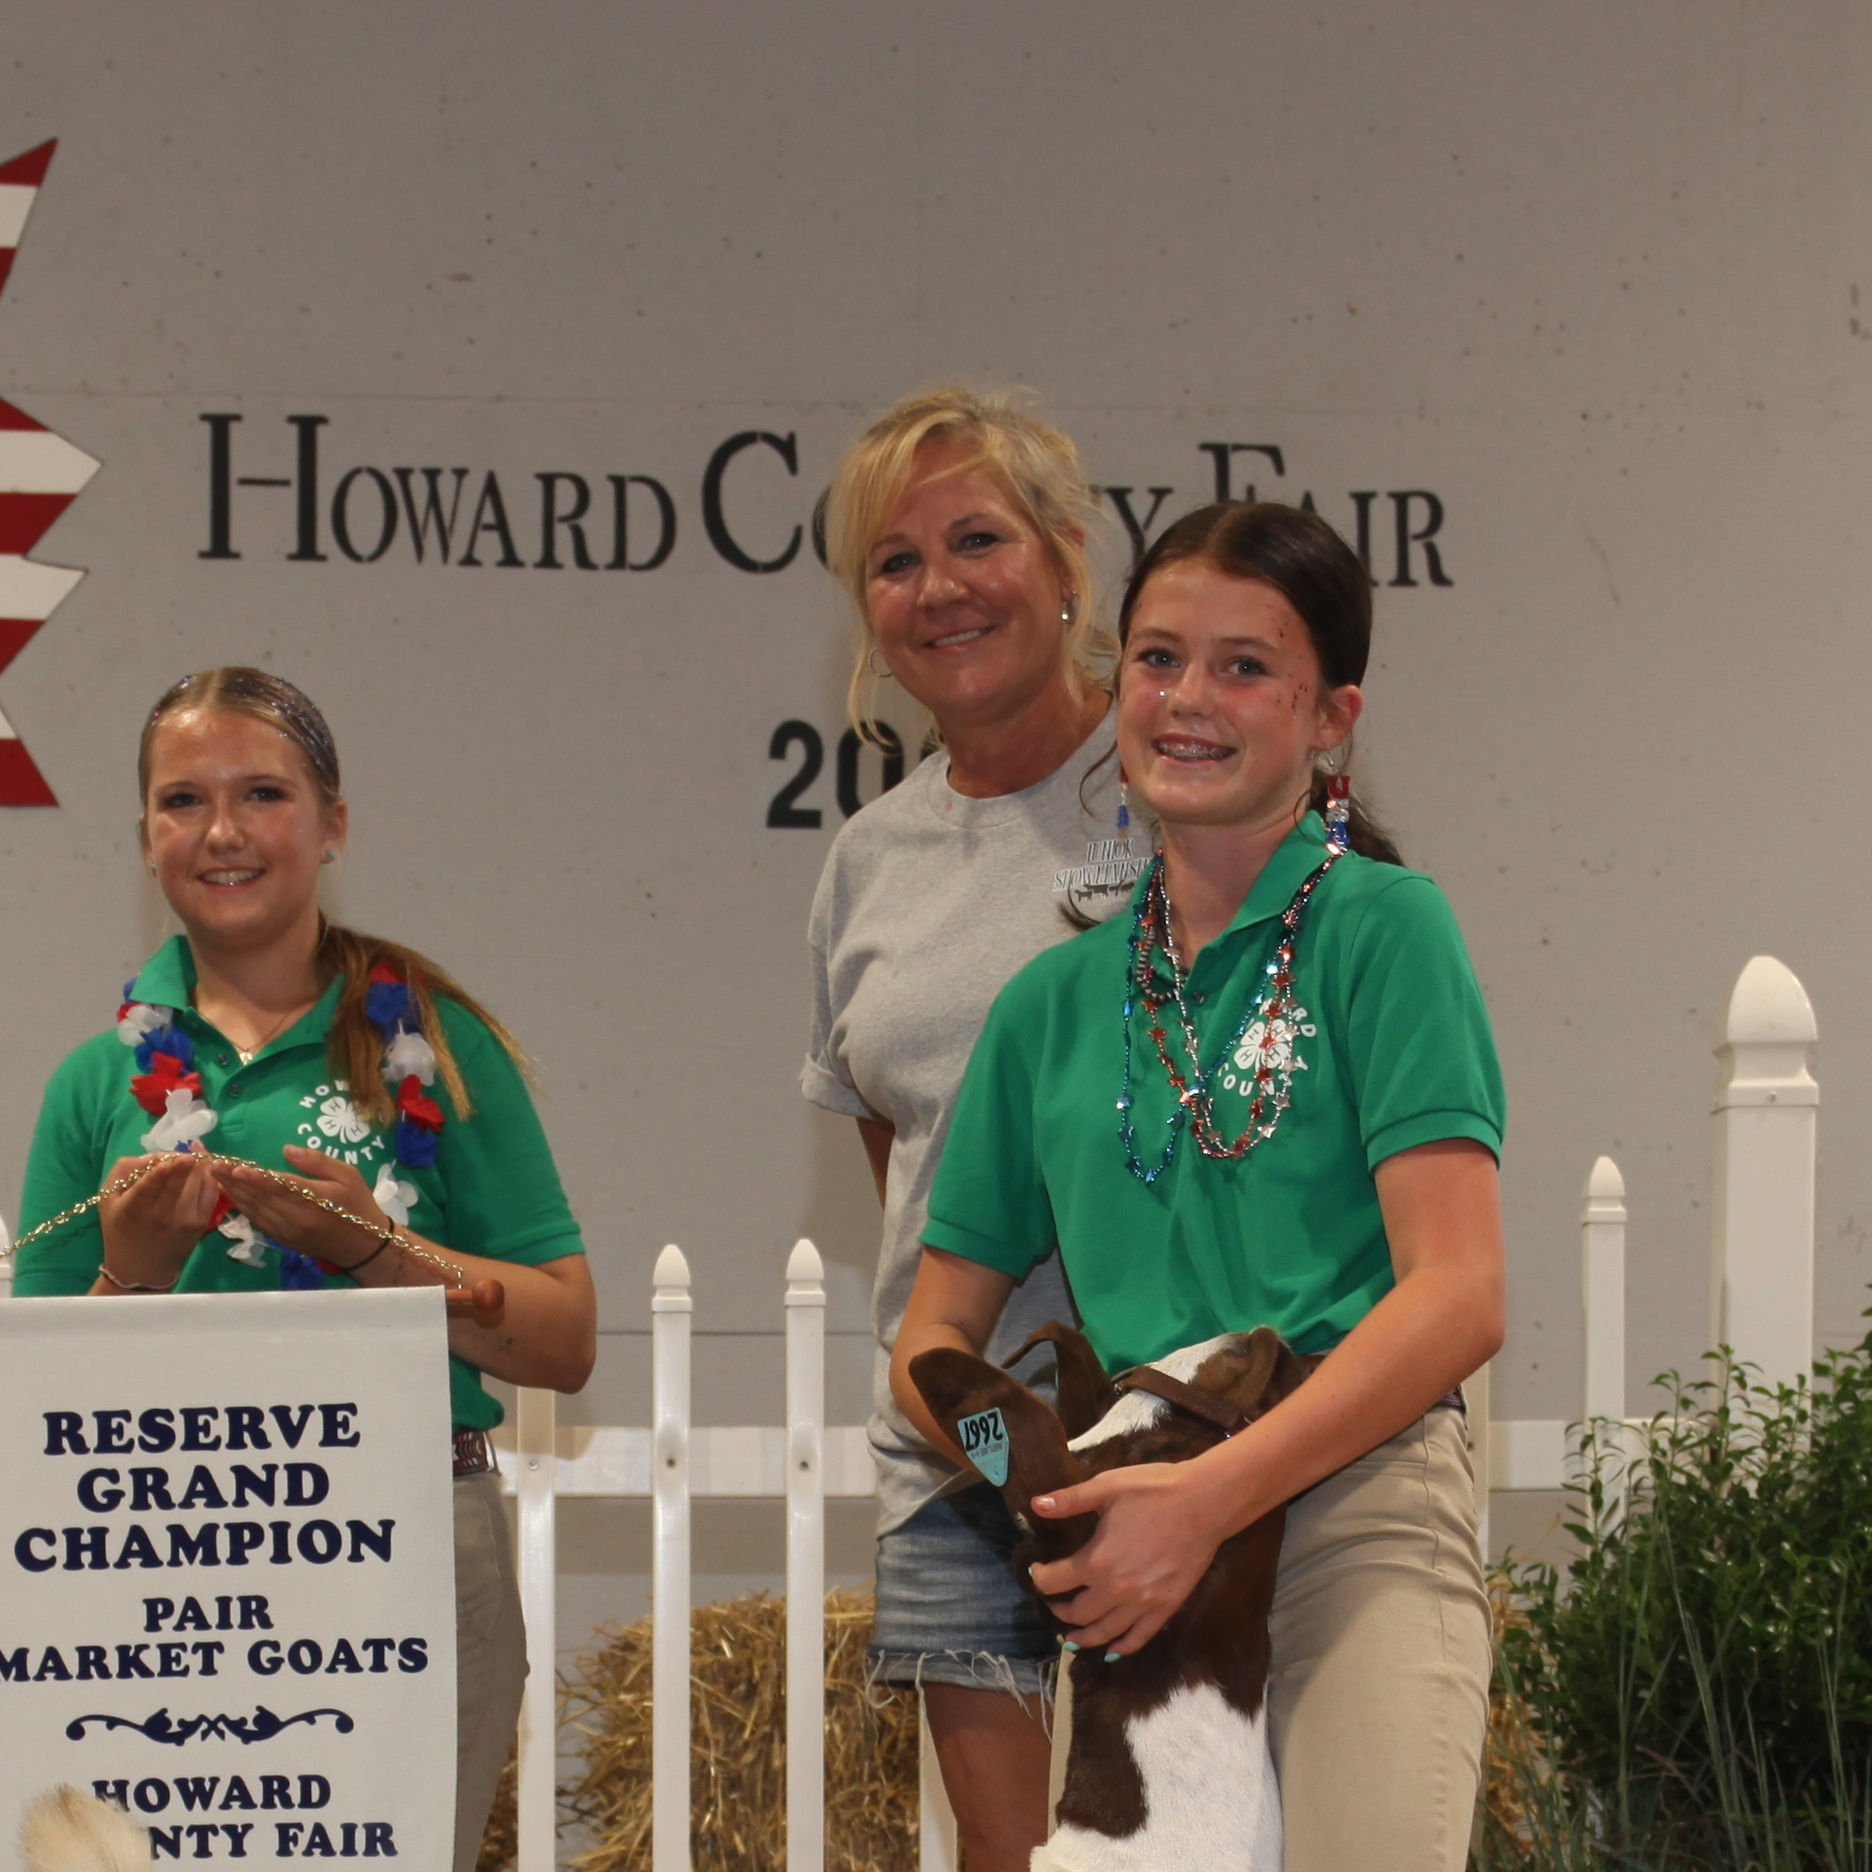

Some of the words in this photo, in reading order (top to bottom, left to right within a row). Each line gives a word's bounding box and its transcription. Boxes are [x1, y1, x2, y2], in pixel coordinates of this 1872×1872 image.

[197, 412, 678, 573] HOWARD
[765, 718, 947, 831] 20
[296, 1122, 386, 1166] COUNTY
[42, 1402, 362, 1456] RESERVE
[963, 1411, 1004, 1452] 2667
[76, 1462, 331, 1513] GRAND
[13, 1518, 397, 1573] CHAMPION
[142, 1594, 275, 1633] PAIR
[246, 1637, 429, 1676] GOATS
[148, 1822, 255, 1860] NTY
[275, 1821, 399, 1858] FAIR
